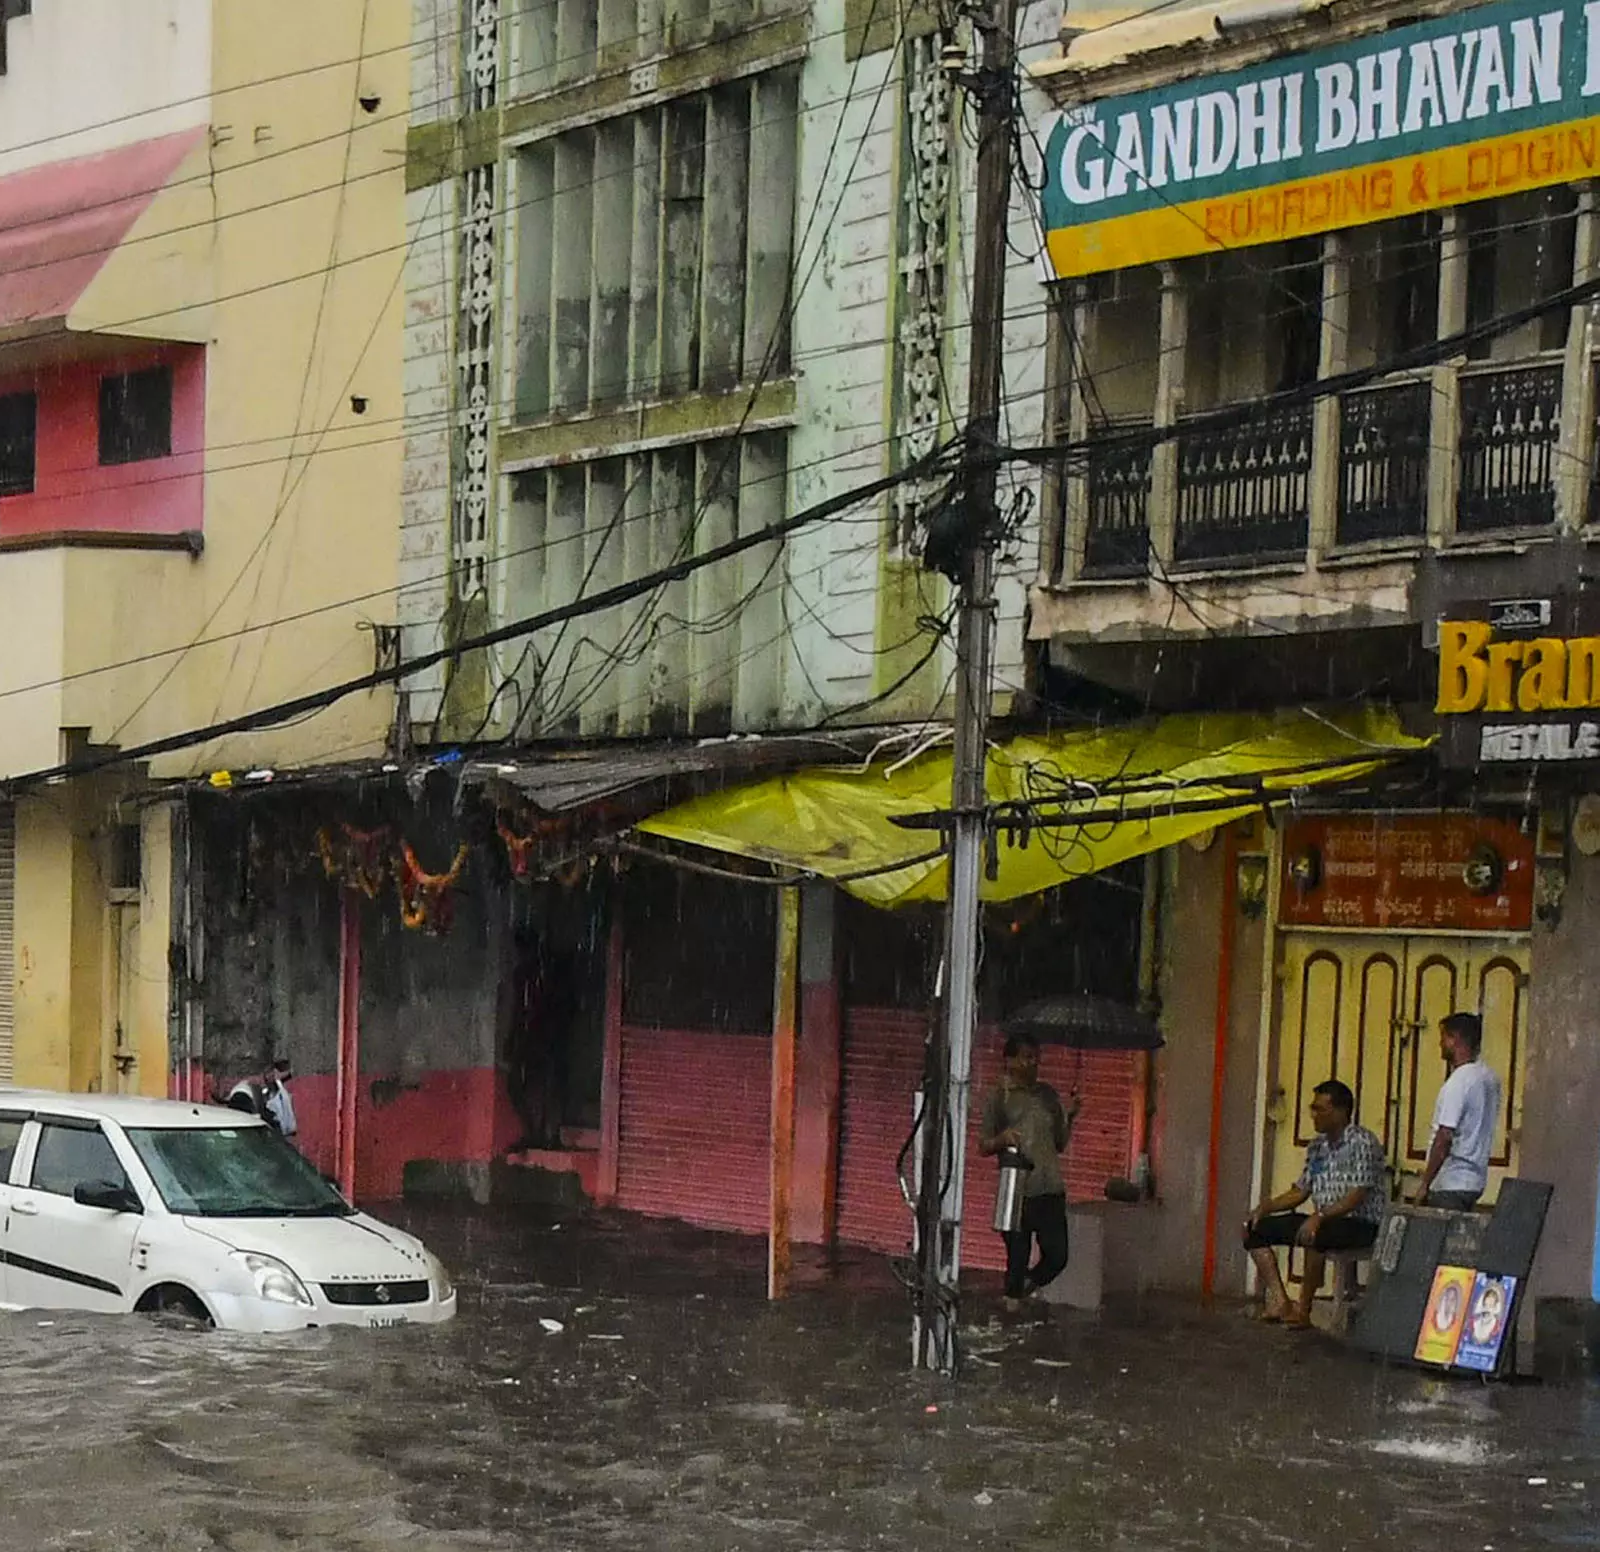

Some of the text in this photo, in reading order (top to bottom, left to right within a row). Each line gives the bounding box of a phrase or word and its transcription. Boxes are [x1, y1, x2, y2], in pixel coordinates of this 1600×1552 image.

[1060, 72, 1304, 204] GANDHI
[1315, 10, 1564, 153] BHAVAN
[1204, 167, 1395, 244] BOARDING
[1408, 159, 1430, 206] &
